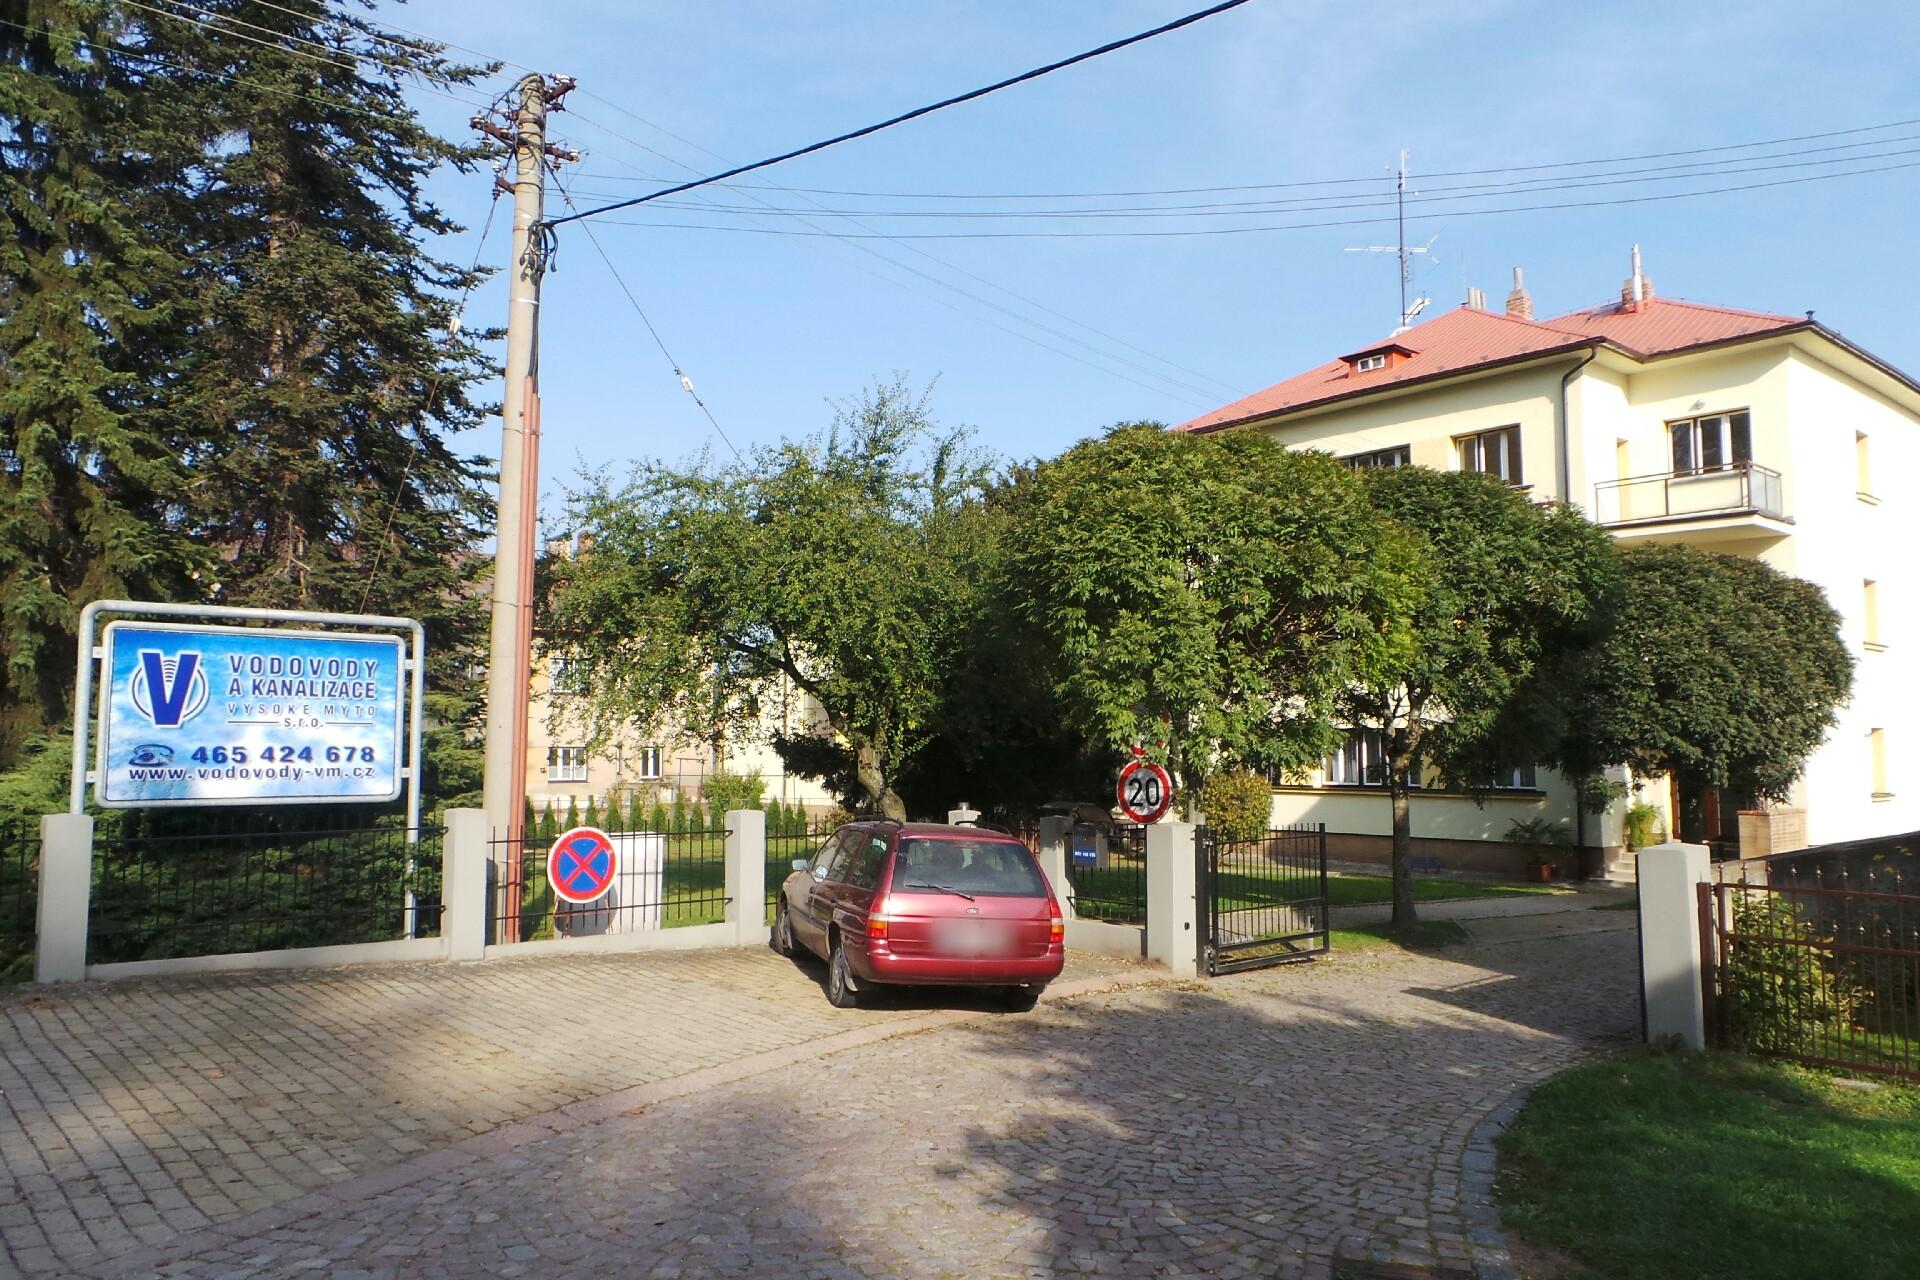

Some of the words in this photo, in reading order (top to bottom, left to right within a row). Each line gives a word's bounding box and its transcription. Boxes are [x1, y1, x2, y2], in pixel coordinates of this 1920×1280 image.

[229, 655, 377, 678] VODOVODY
[229, 678, 242, 696] A
[252, 678, 376, 699] KANALIZACE
[190, 746, 248, 764] 465
[260, 746, 314, 763] 424
[325, 746, 376, 763] 678
[128, 764, 375, 781] www.vodovody-vm.cz
[1128, 777, 1160, 807] 20
